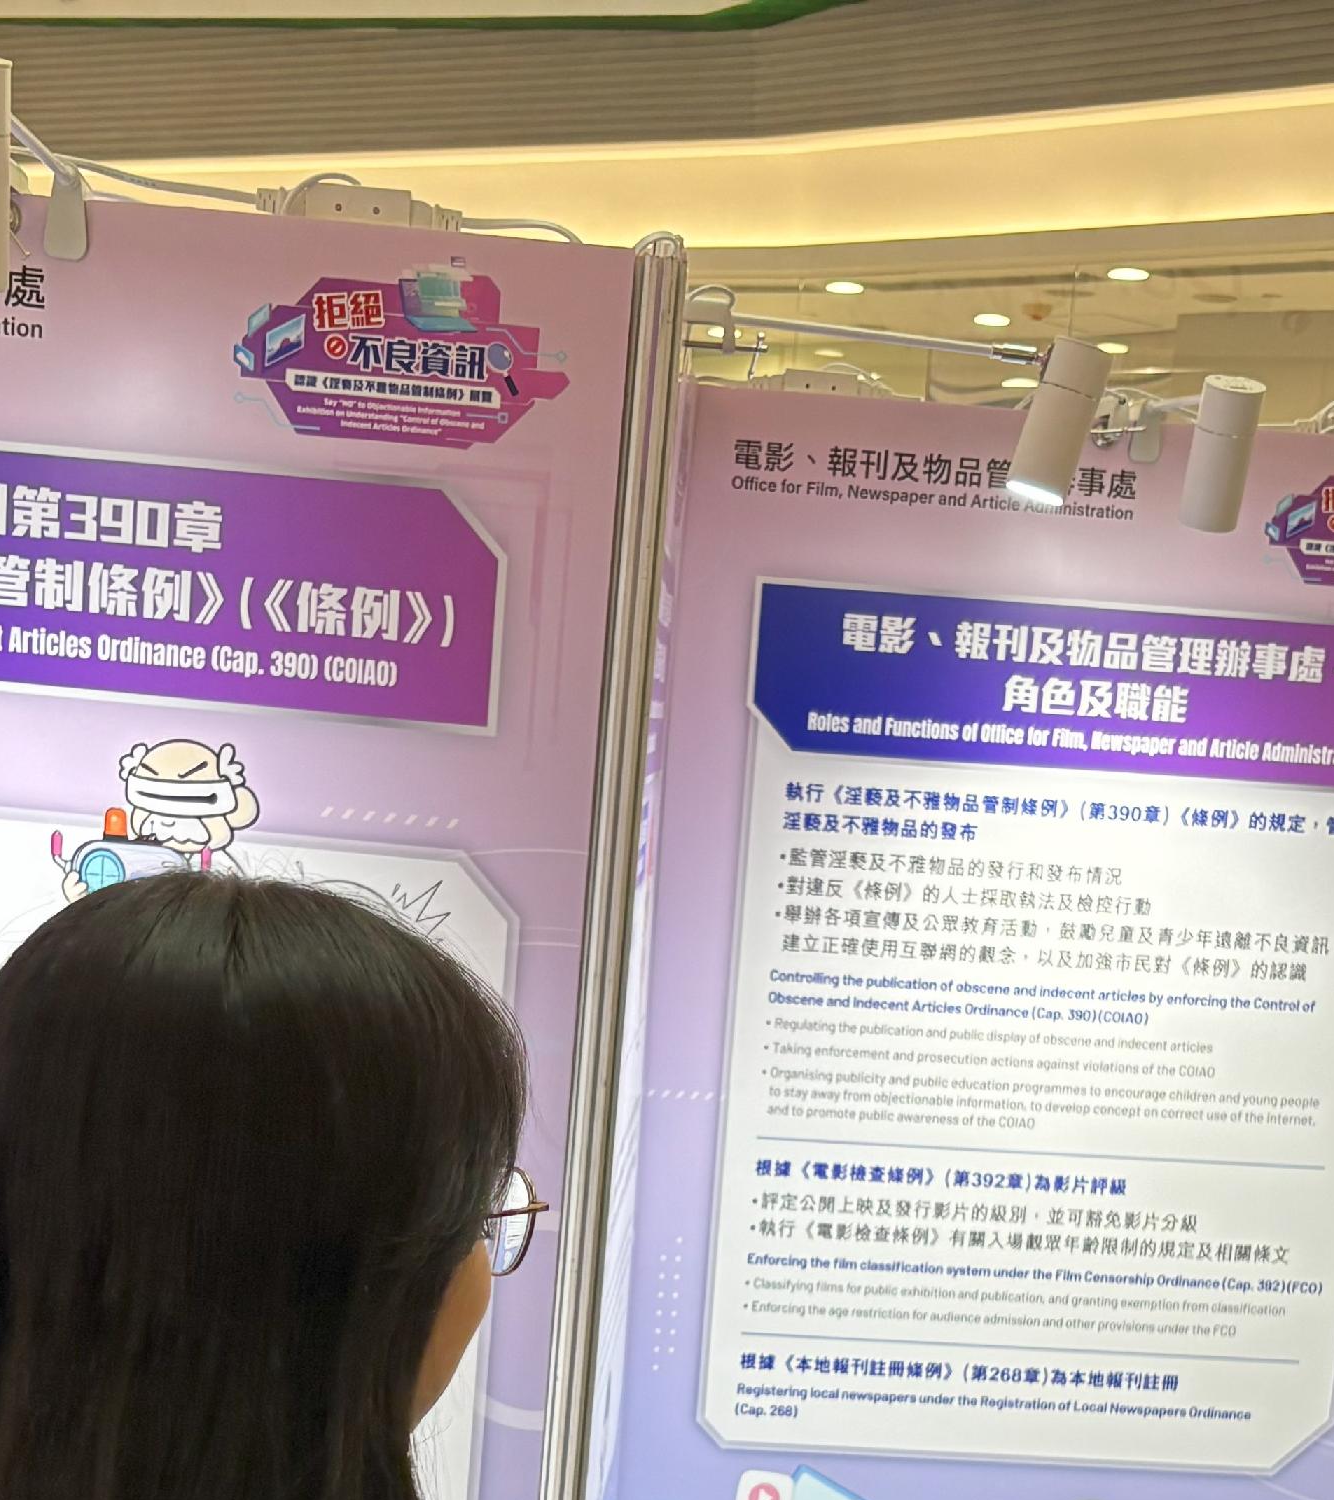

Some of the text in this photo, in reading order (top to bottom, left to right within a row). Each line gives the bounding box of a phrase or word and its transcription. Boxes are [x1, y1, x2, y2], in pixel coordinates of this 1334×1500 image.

[314, 291, 384, 329] 拒絕
[349, 334, 487, 381] 不良資訊
[732, 475, 776, 493] Office
[781, 479, 802, 494] for
[807, 481, 842, 499] Film,
[848, 484, 935, 507] Newspaper
[939, 492, 967, 507] and
[971, 493, 1020, 511] Article
[733, 439, 1138, 500] 電影、報刊及物品管事處
[9, 626, 91, 659] Articles
[98, 633, 205, 669] Ordinance
[212, 645, 264, 678] (Cap.
[270, 650, 318, 680] 390)
[324, 656, 397, 687] (COIAO)
[841, 612, 1327, 684] 電影、報刊及物品管理辦事處
[1002, 675, 1189, 724] 角色及職能
[808, 711, 850, 733] Roles
[853, 715, 882, 736] and
[885, 717, 959, 741] Functions
[962, 722, 979, 742] of
[981, 723, 1024, 745] Office
[1027, 725, 1050, 747] for
[1052, 727, 1088, 751] Film,
[1091, 730, 1176, 756] Newspaper
[1178, 737, 1208, 757] and
[1210, 739, 1259, 760] Article
[782, 811, 979, 842] 淫褻及不雅物品的發布
[735, 1403, 798, 1418] (Cap. 268)
[737, 1383, 1251, 1420] Registering local newspapers under the Registration of Local Newspapers Ordinance
